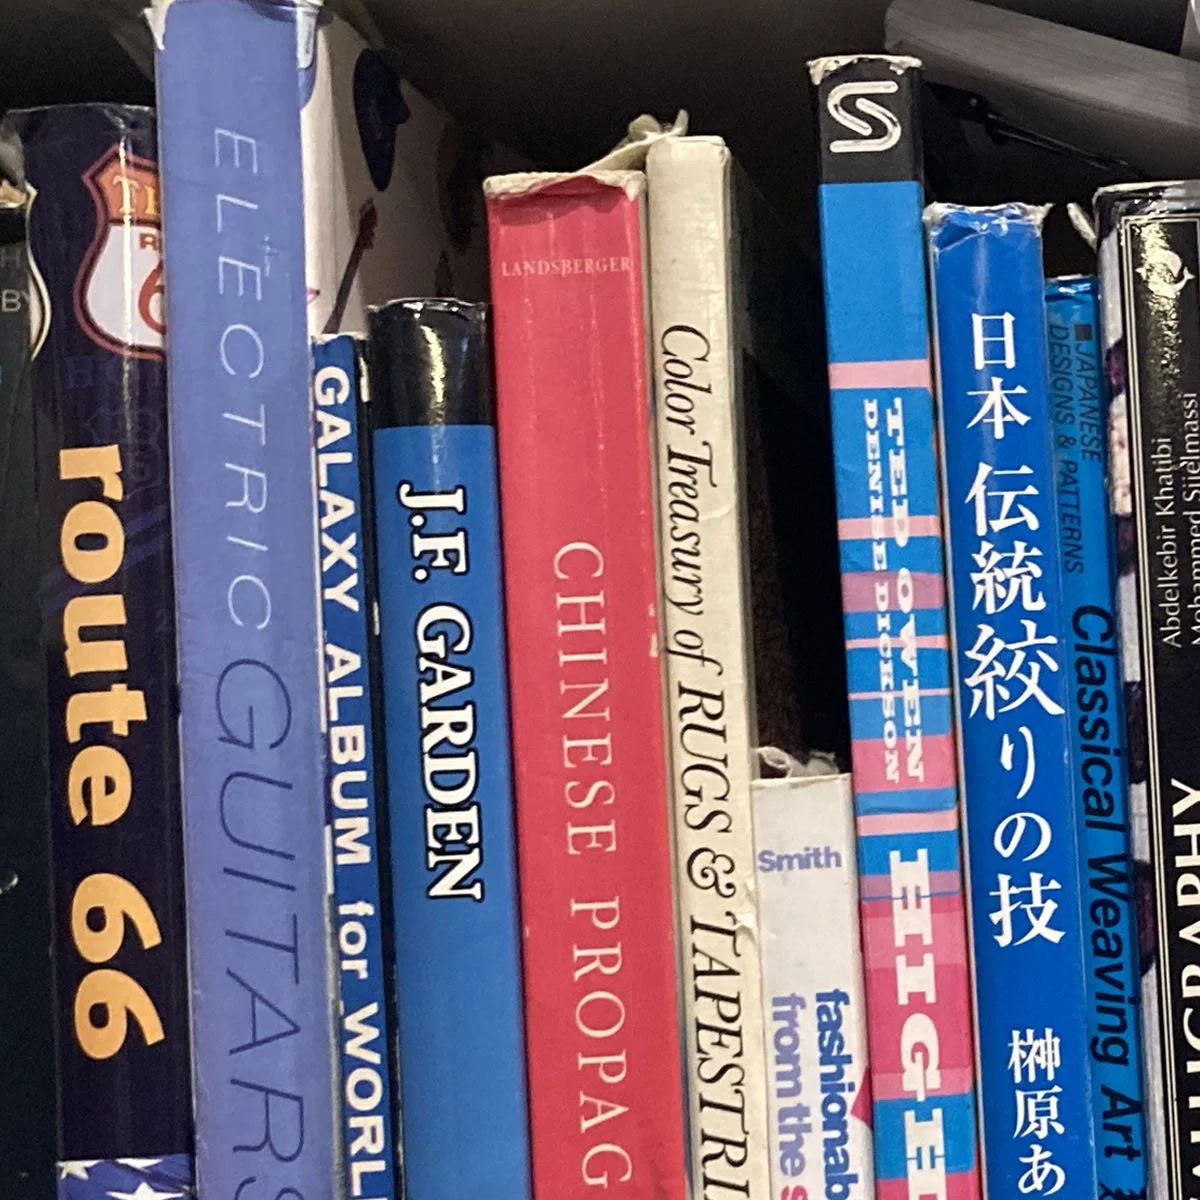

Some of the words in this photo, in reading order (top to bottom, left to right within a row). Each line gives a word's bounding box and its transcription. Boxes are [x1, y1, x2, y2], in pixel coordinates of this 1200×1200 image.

[501, 256, 632, 276] LANDSBERGER
[213, 127, 272, 629] ELECTRIC
[660, 323, 713, 436] Color
[1049, 324, 1076, 426] DESIGNS
[1074, 342, 1102, 464] JAPANESE
[312, 366, 361, 613] GALAXY
[862, 397, 888, 571] DENISE
[885, 396, 915, 549] TED
[1057, 434, 1076, 449] &
[1151, 437, 1174, 516] Khatibi
[398, 481, 470, 582] J.F.
[662, 440, 718, 617] Treasury
[1058, 458, 1085, 575] PATTERNS
[59, 444, 148, 827] route
[1156, 523, 1182, 647] Abdelkebir
[553, 541, 617, 857] CHINESE
[666, 627, 724, 677] of
[874, 580, 901, 784] DICKSON
[897, 567, 925, 783] OWEN
[323, 651, 374, 865] ALBUM
[414, 603, 484, 901] GARDEN
[677, 680, 734, 839] RUGS
[1071, 605, 1123, 832] Classical
[686, 846, 737, 900] &
[758, 846, 843, 874] Smith
[71, 873, 165, 1060] 66
[336, 902, 376, 979] for
[1084, 848, 1132, 1068] Weaving
[771, 993, 807, 1096] from
[779, 1101, 810, 1178] the
[1101, 1088, 1142, 1162] Art
